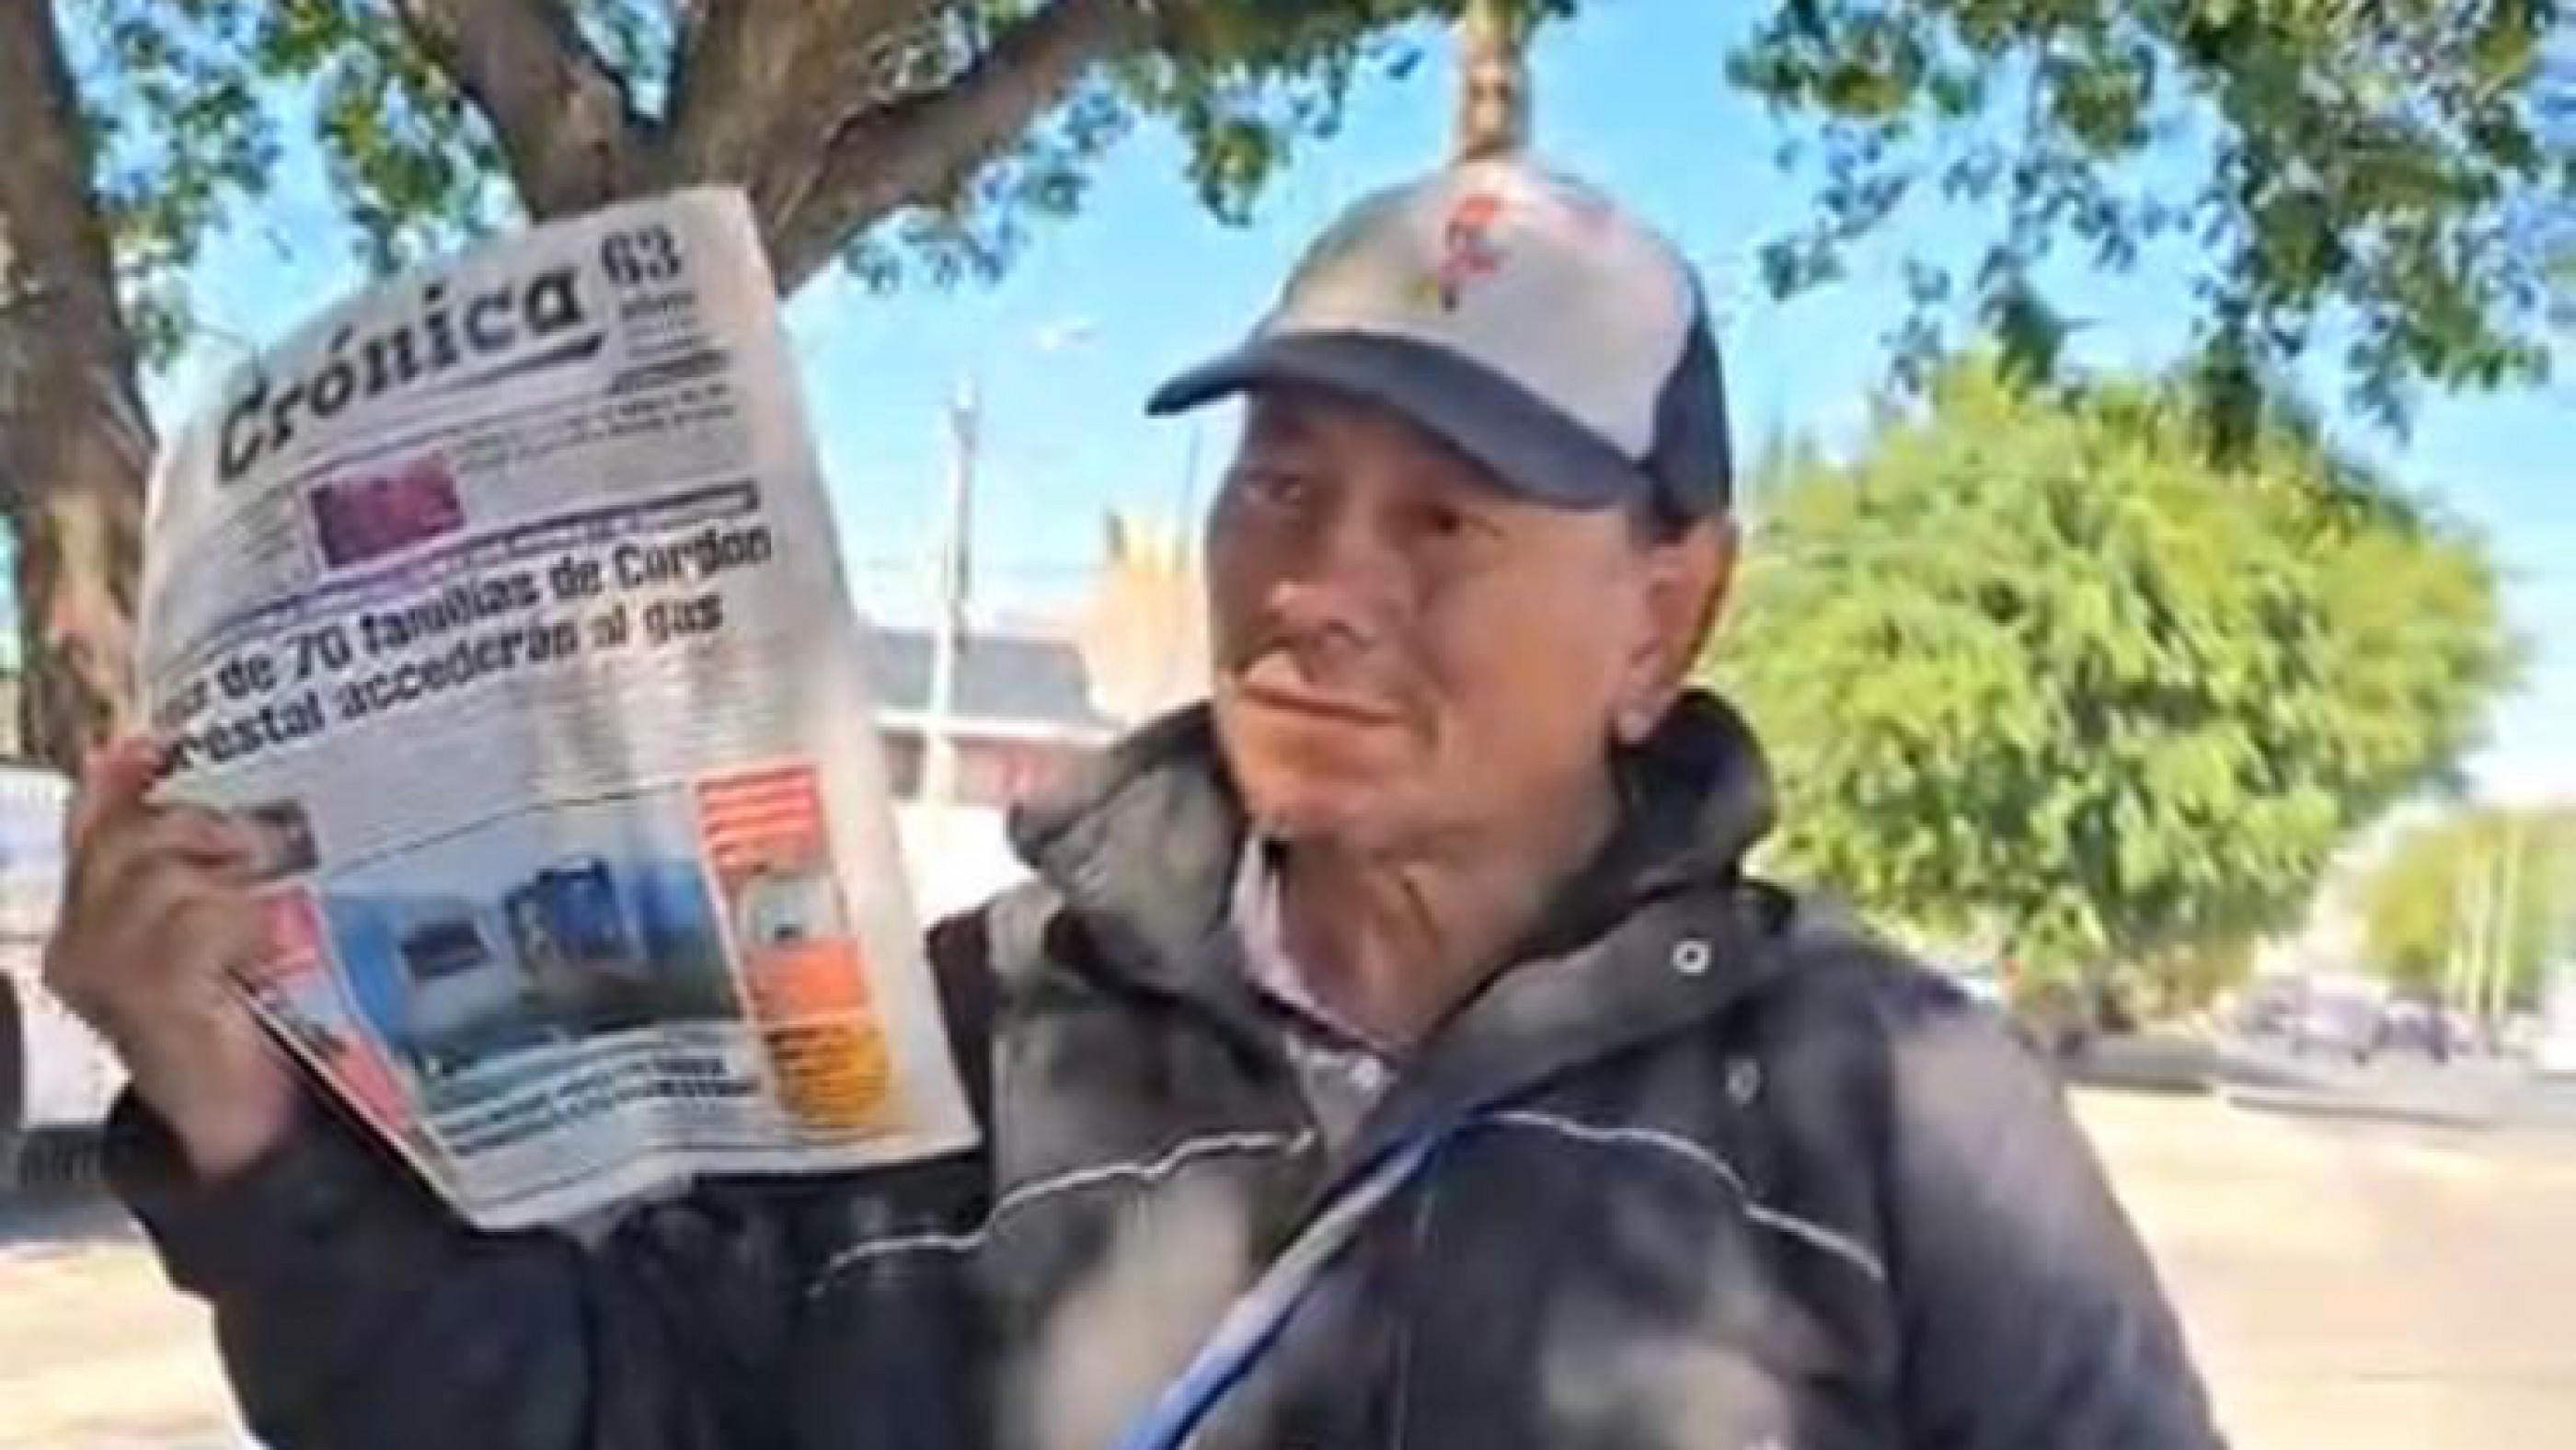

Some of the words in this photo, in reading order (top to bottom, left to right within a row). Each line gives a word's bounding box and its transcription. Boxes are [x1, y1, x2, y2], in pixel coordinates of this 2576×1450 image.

[602, 223, 683, 287] 63
[217, 264, 587, 484] Crónica
[218, 654, 275, 700] de
[282, 625, 351, 679] 70
[551, 556, 603, 600] de
[592, 603, 627, 648] al
[644, 593, 723, 647] gas
